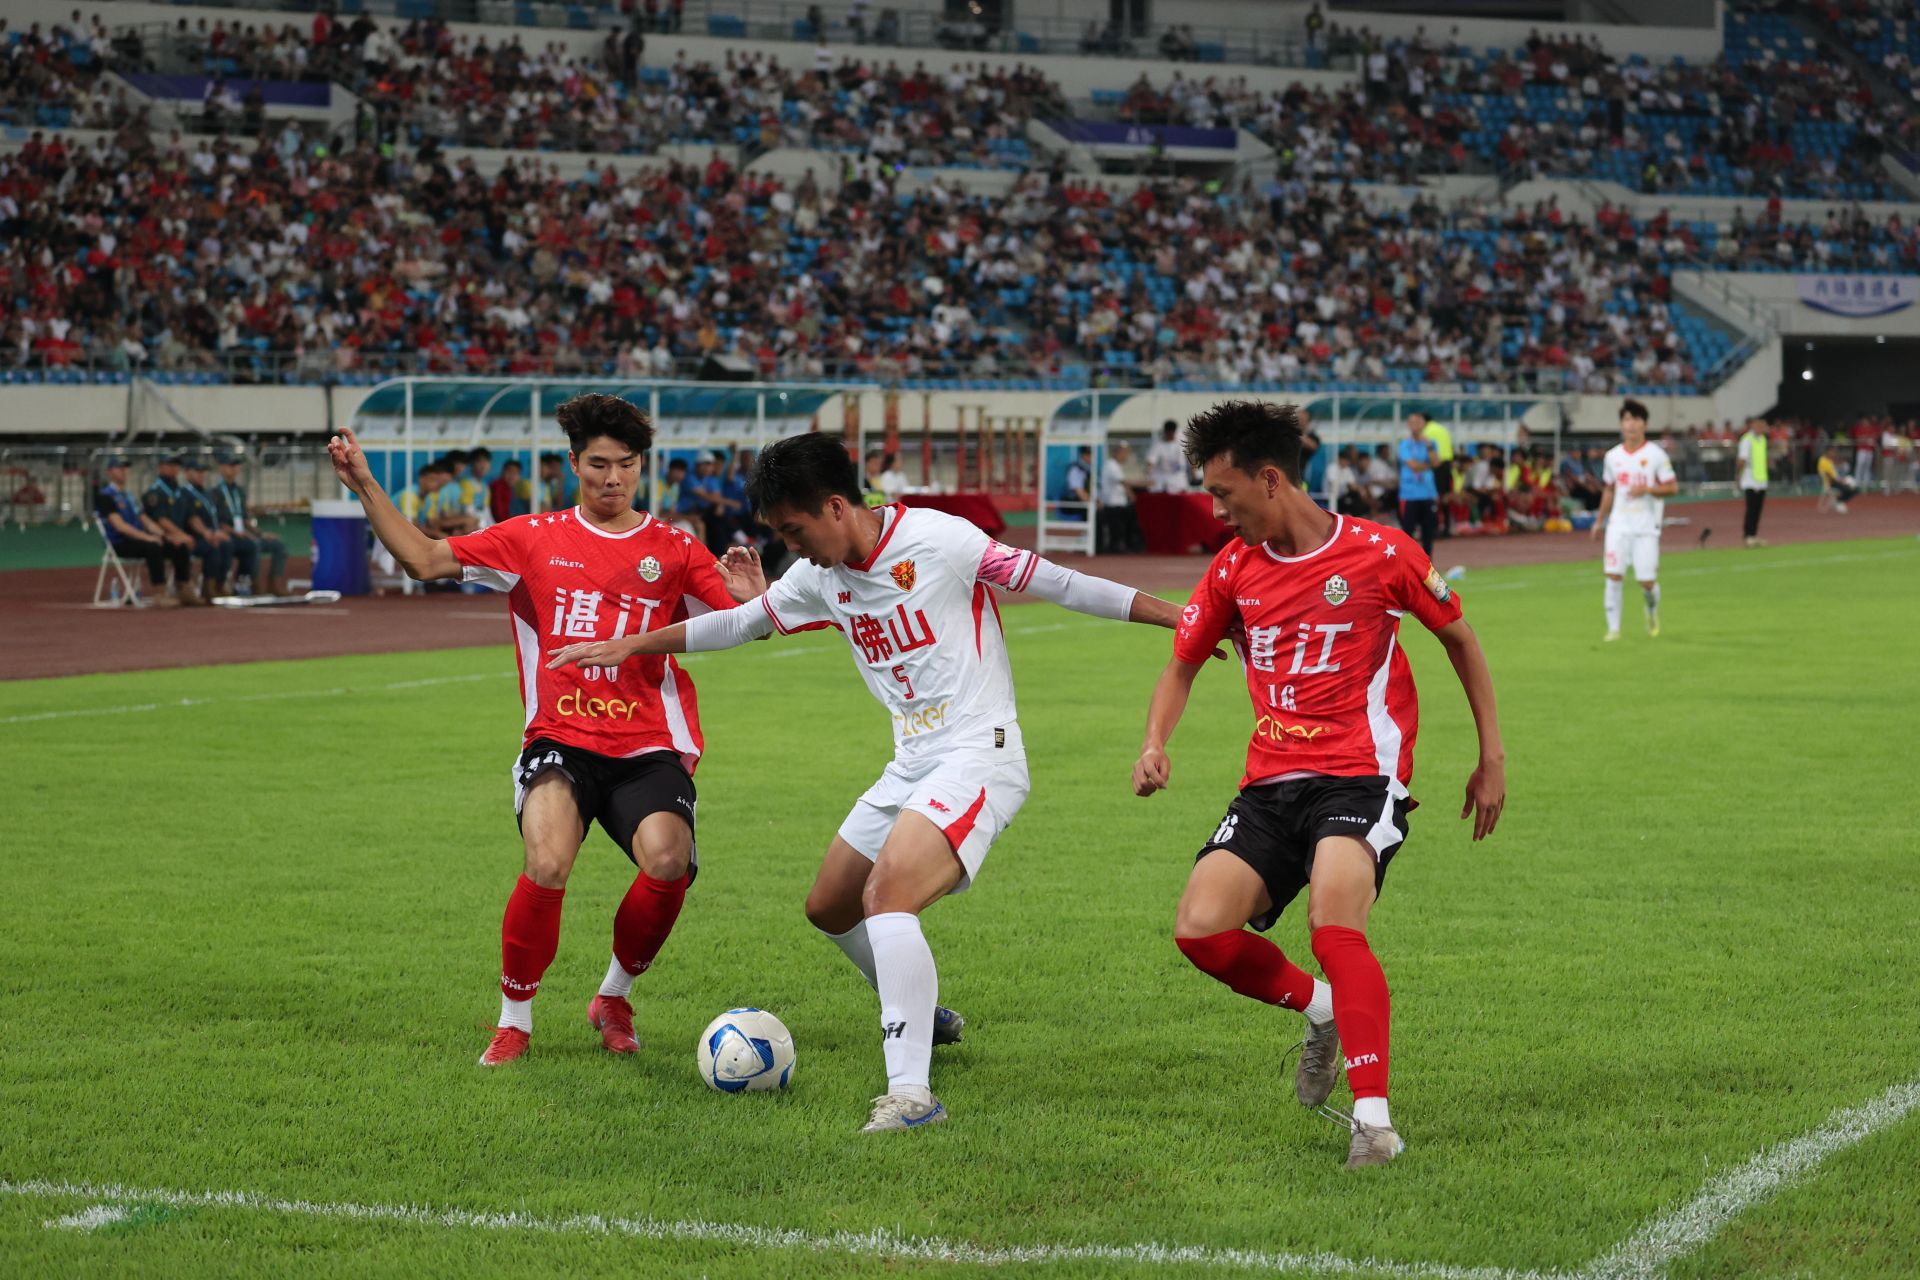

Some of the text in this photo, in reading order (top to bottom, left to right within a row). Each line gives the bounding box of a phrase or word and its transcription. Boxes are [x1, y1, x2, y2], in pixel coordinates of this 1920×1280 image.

[549, 558, 584, 569] ATHLETA
[550, 587, 661, 640] 湛江
[850, 603, 937, 664] 佛山
[892, 665, 914, 700] 5
